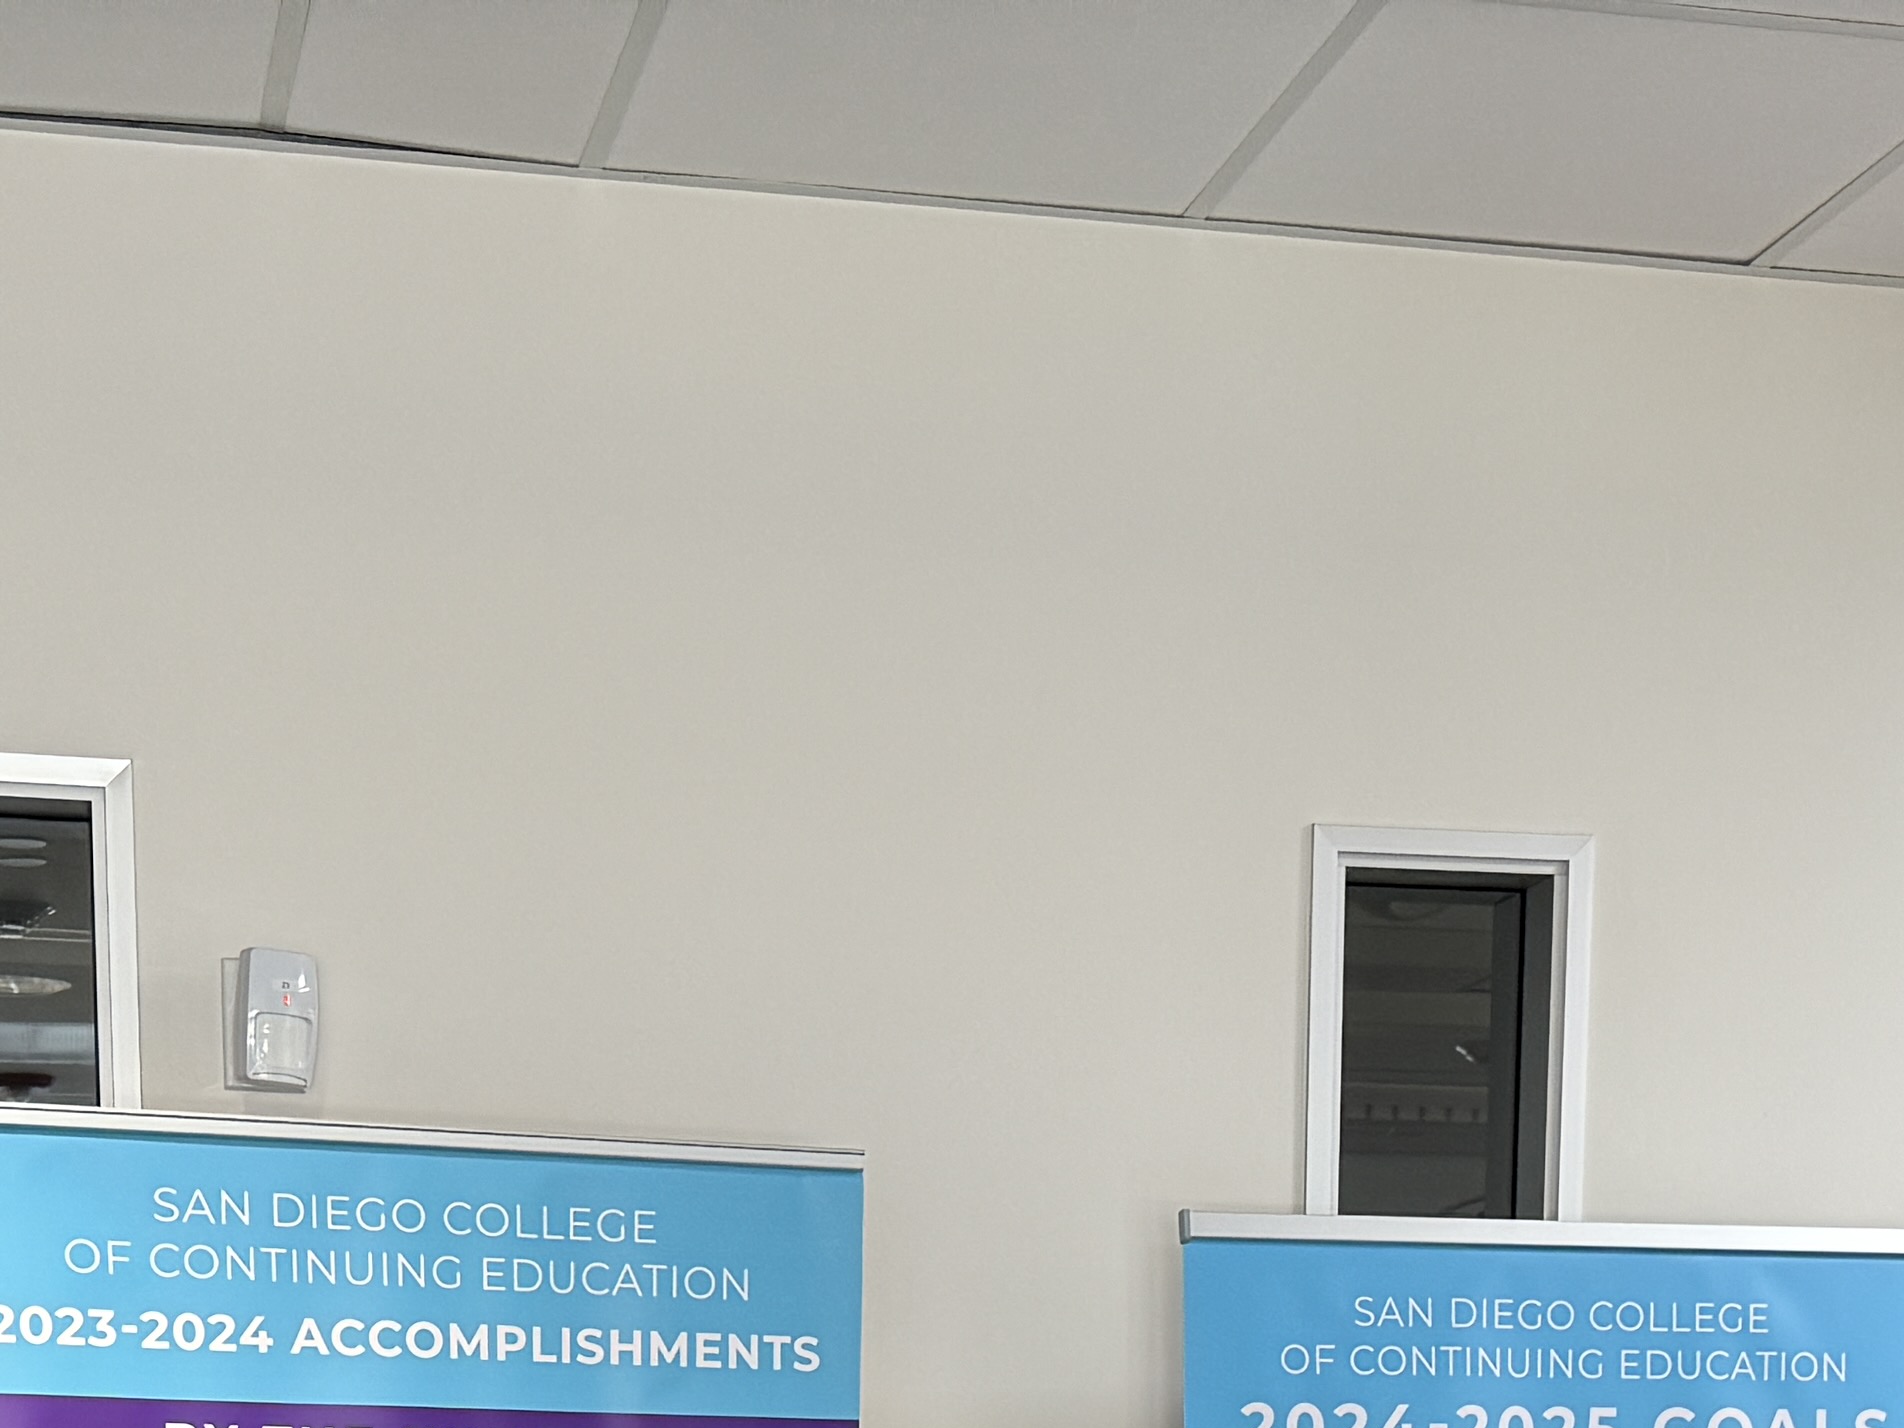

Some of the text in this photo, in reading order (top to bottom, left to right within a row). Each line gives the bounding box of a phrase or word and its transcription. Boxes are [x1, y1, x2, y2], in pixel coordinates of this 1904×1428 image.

[153, 1188, 657, 1245] SAN DIEGO COLLEGE
[64, 1237, 749, 1302] OF CONTINUING EDUCATION
[1354, 1296, 1768, 1334] SAN DIEGO COLLEGE
[291, 1317, 821, 1372] ACCOMPLISHMENTS
[1281, 1345, 1847, 1383] OF CONTINUING EDUCATION
